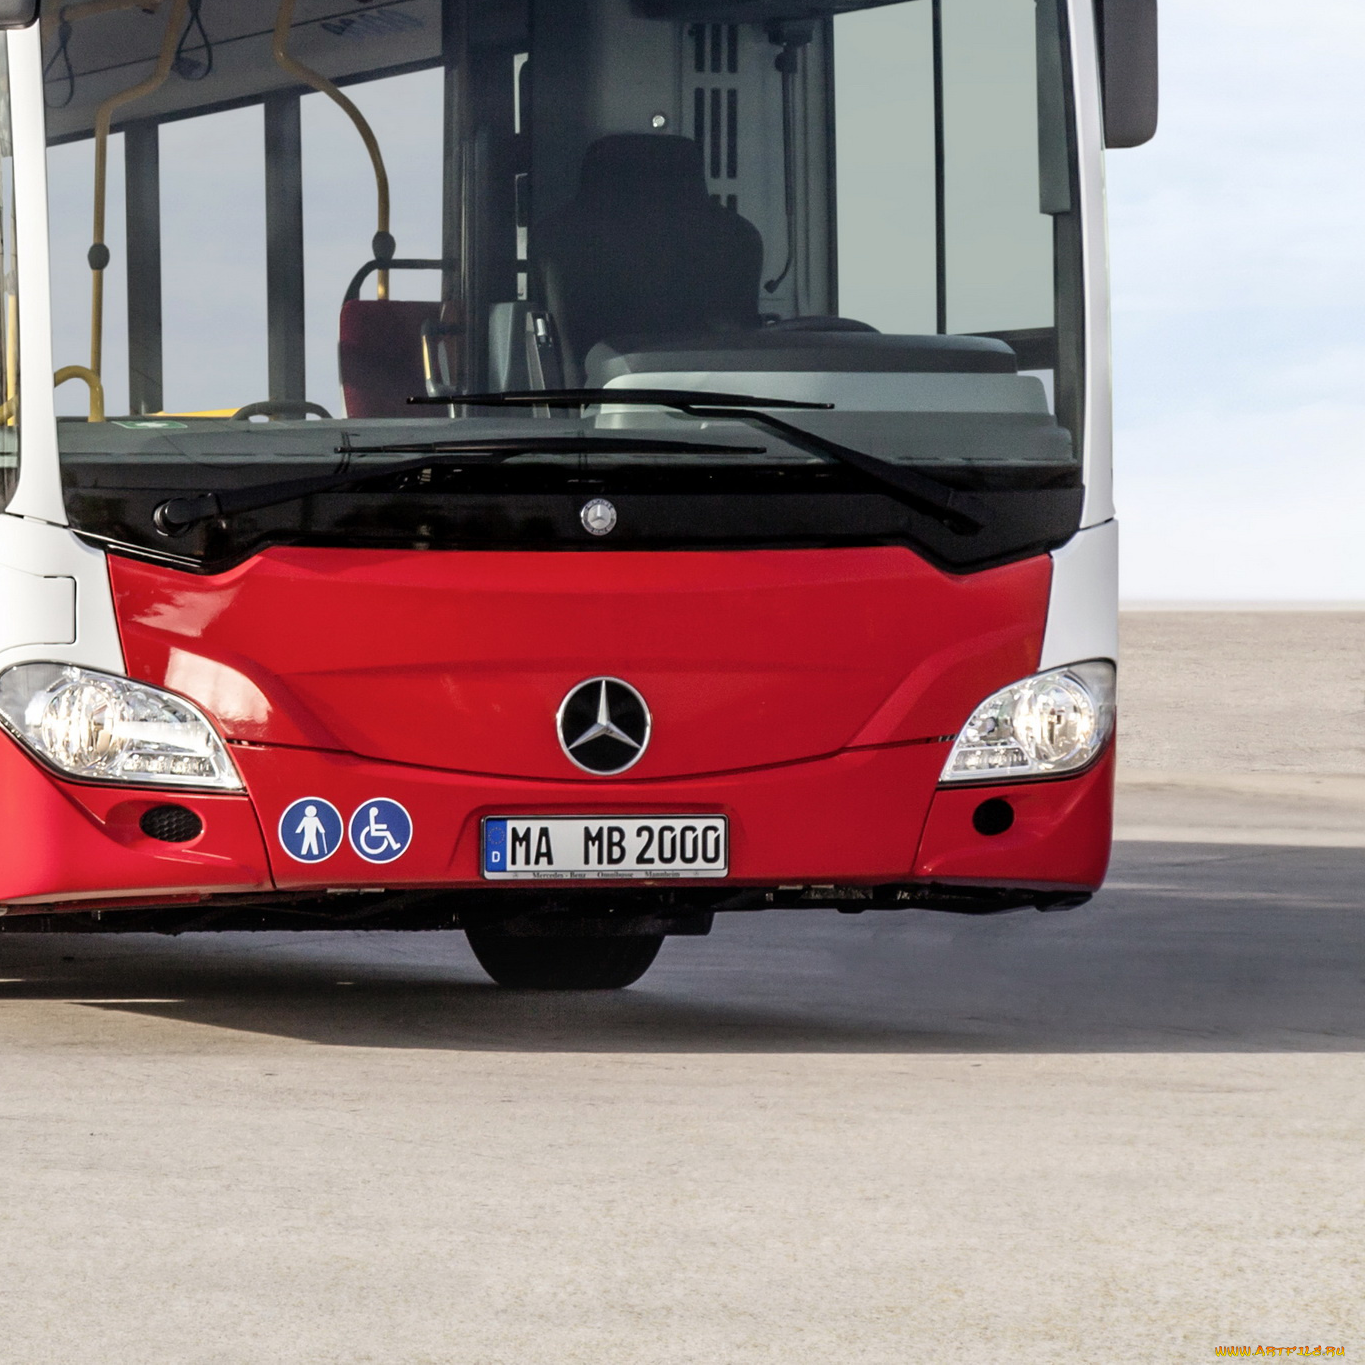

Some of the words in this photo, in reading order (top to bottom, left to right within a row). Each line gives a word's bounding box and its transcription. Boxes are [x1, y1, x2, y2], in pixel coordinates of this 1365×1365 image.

[491, 850, 501, 863] D
[511, 827, 554, 865] MA
[583, 826, 626, 865] MB
[635, 825, 721, 865] 2000
